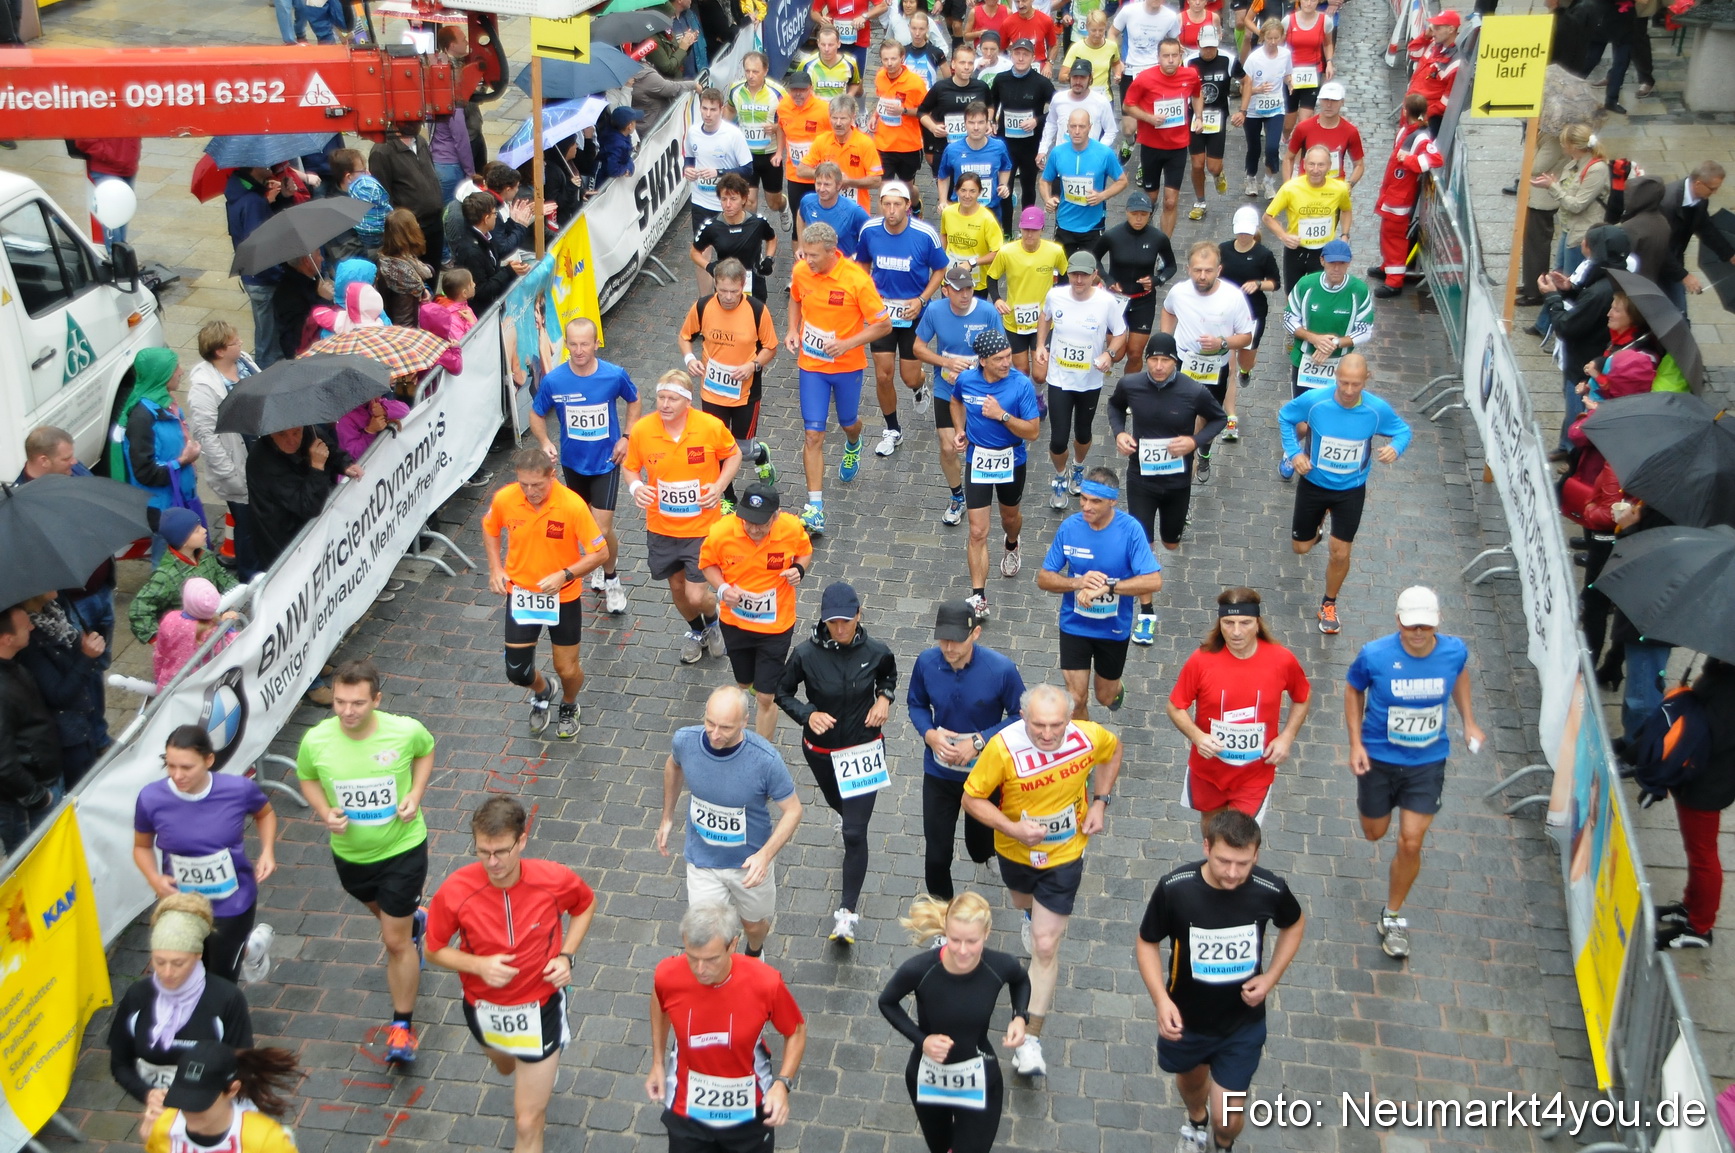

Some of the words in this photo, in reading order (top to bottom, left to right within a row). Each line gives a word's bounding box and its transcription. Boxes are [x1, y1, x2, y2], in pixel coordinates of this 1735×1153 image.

[1480, 43, 1546, 60] Jugend-
[1296, 73, 1313, 83] 547
[1496, 63, 1526, 79] lauf
[126, 83, 206, 108] 09181
[216, 81, 286, 107] 6352
[1068, 184, 1086, 196] 241
[1305, 226, 1327, 238] 488
[1017, 310, 1039, 324] 520
[1062, 347, 1085, 361] 133
[1190, 360, 1214, 374] 316
[1303, 362, 1335, 377] 2570
[571, 413, 605, 428] 2610
[1143, 447, 1179, 463] 257
[1323, 446, 1360, 461] 2571
[976, 456, 1010, 471] 2479
[661, 489, 698, 505] 2659
[669, 506, 690, 514] Konrad
[369, 516, 396, 562] Mehr
[516, 593, 556, 610] 3156
[257, 581, 309, 679] BMW
[1391, 678, 1444, 692] HUBER
[1393, 714, 1437, 732] 2776
[1226, 752, 1246, 760] Josef
[840, 753, 882, 778] 2184
[851, 777, 878, 789] Barbara
[1019, 773, 1056, 793] MAX
[342, 788, 392, 808] 2943
[356, 812, 383, 823] Tobias
[696, 808, 741, 832] 2856
[705, 830, 729, 842] Pierre
[179, 863, 229, 885] 2941
[1197, 940, 1252, 961] 2262
[1202, 965, 1245, 974] alexander
[490, 1013, 529, 1034] 568
[924, 1069, 978, 1089] 3191
[694, 1086, 750, 1108] 2285
[709, 1110, 732, 1119] Ernst
